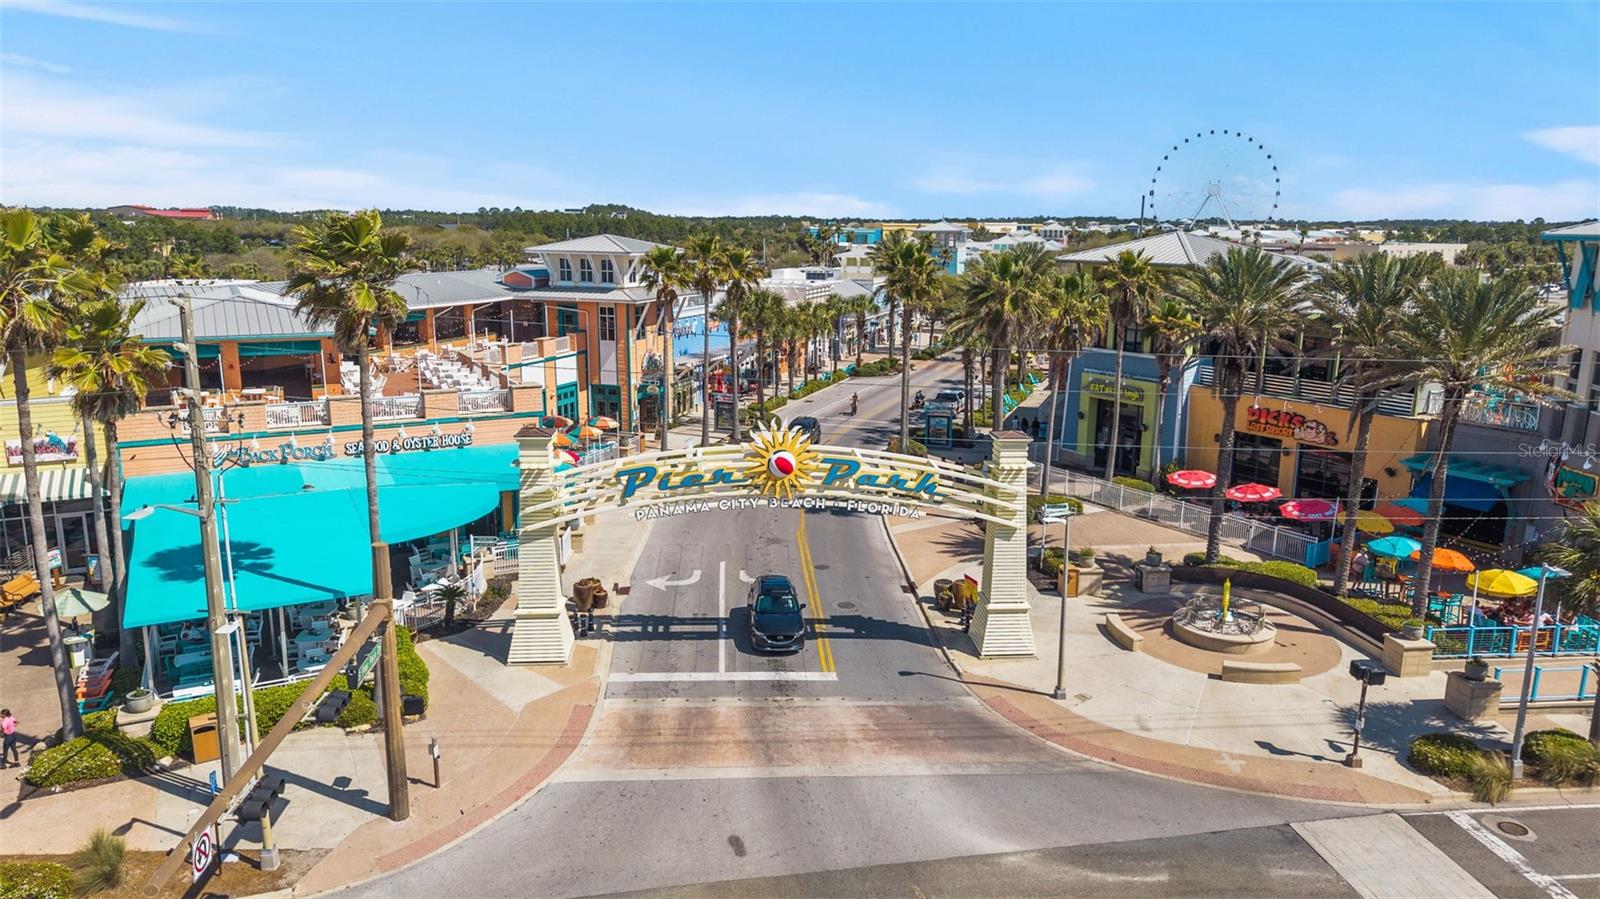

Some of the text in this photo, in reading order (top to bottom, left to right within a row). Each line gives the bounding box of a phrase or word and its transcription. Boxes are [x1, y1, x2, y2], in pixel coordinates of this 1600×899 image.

[391, 438, 400, 451] &
[403, 436, 439, 450] OYSTER
[441, 433, 472, 446] HOUSE
[614, 457, 949, 499] Pier Park
[634, 496, 921, 522] PANAMA CITY BEACH FLORIDA
